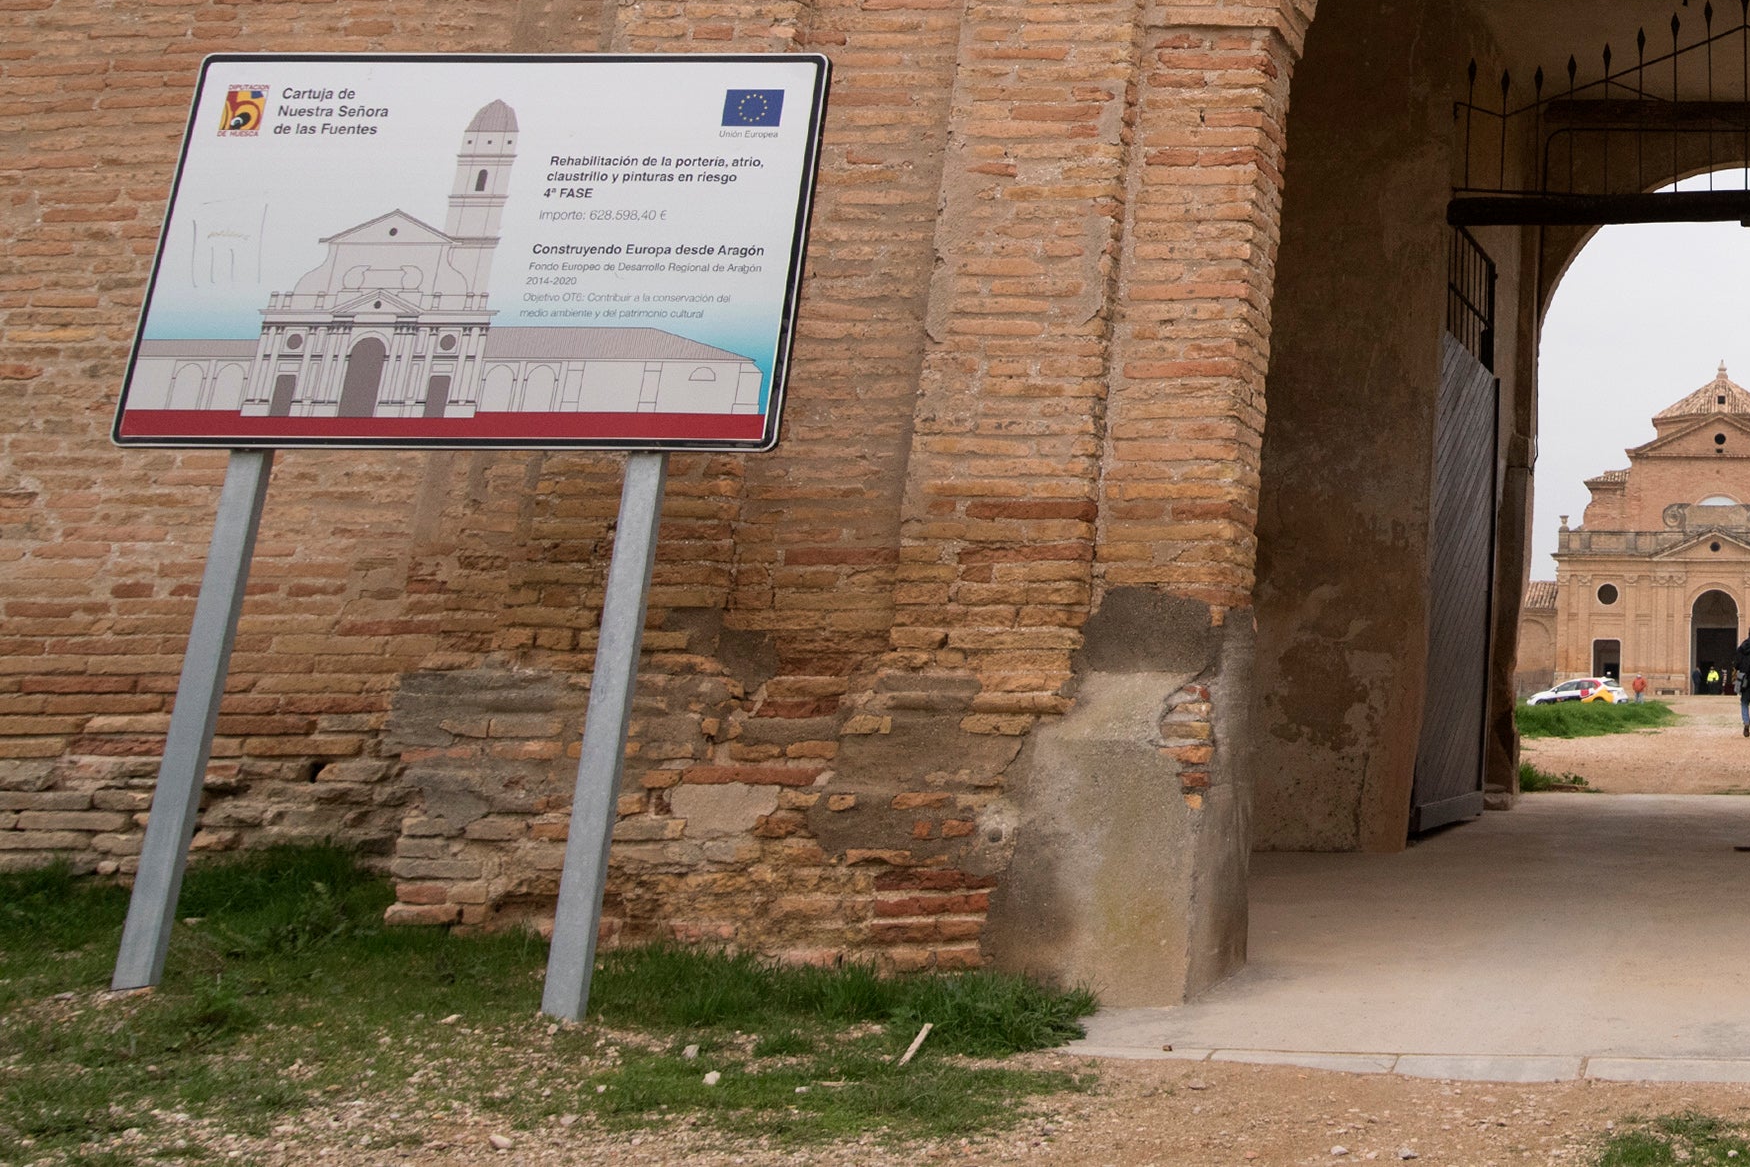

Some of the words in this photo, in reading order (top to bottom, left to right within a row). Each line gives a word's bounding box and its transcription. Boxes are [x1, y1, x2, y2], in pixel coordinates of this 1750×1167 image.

[282, 87, 333, 102] Cartuja
[338, 88, 356, 100] de
[278, 106, 333, 118] Nuestra
[338, 105, 389, 118] Señora
[274, 123, 292, 135] de
[296, 123, 316, 135] las
[321, 124, 378, 135] Fuentes
[719, 130, 743, 138] Unión
[745, 130, 779, 139] Europea
[550, 156, 639, 166] Rehabilitación
[642, 156, 658, 167] de
[661, 156, 672, 167] la
[731, 156, 764, 169] atrio,
[547, 171, 609, 182] claustrillo
[612, 173, 619, 184] y
[623, 172, 674, 184] pinturas
[678, 174, 694, 182] en
[697, 172, 738, 185] riesgo
[560, 188, 594, 198] FASE
[539, 210, 587, 222] Importe:
[590, 210, 657, 222] 628.598,40
[660, 210, 668, 221] €
[533, 243, 622, 257] Construyendo
[626, 244, 672, 257] Europa
[675, 244, 715, 255] desde
[718, 245, 765, 258] Aragón
[529, 262, 559, 271] Fondo
[562, 262, 601, 273] Europeo
[604, 262, 616, 271] de
[618, 262, 666, 272] Desarrollo
[668, 263, 710, 273] Regional
[713, 264, 725, 272] de
[727, 263, 762, 274] Aragón
[526, 277, 577, 286] 2014-2020
[523, 293, 560, 303] Objetivo
[588, 293, 632, 302] Contribuir
[642, 293, 651, 302] la
[653, 294, 714, 303] conservación
[717, 295, 731, 303] del
[520, 309, 549, 318] medio
[550, 309, 593, 318] ambiente
[595, 310, 601, 319] y
[603, 309, 617, 318] del
[619, 309, 668, 320] patrimonio
[670, 310, 704, 319] cultural
